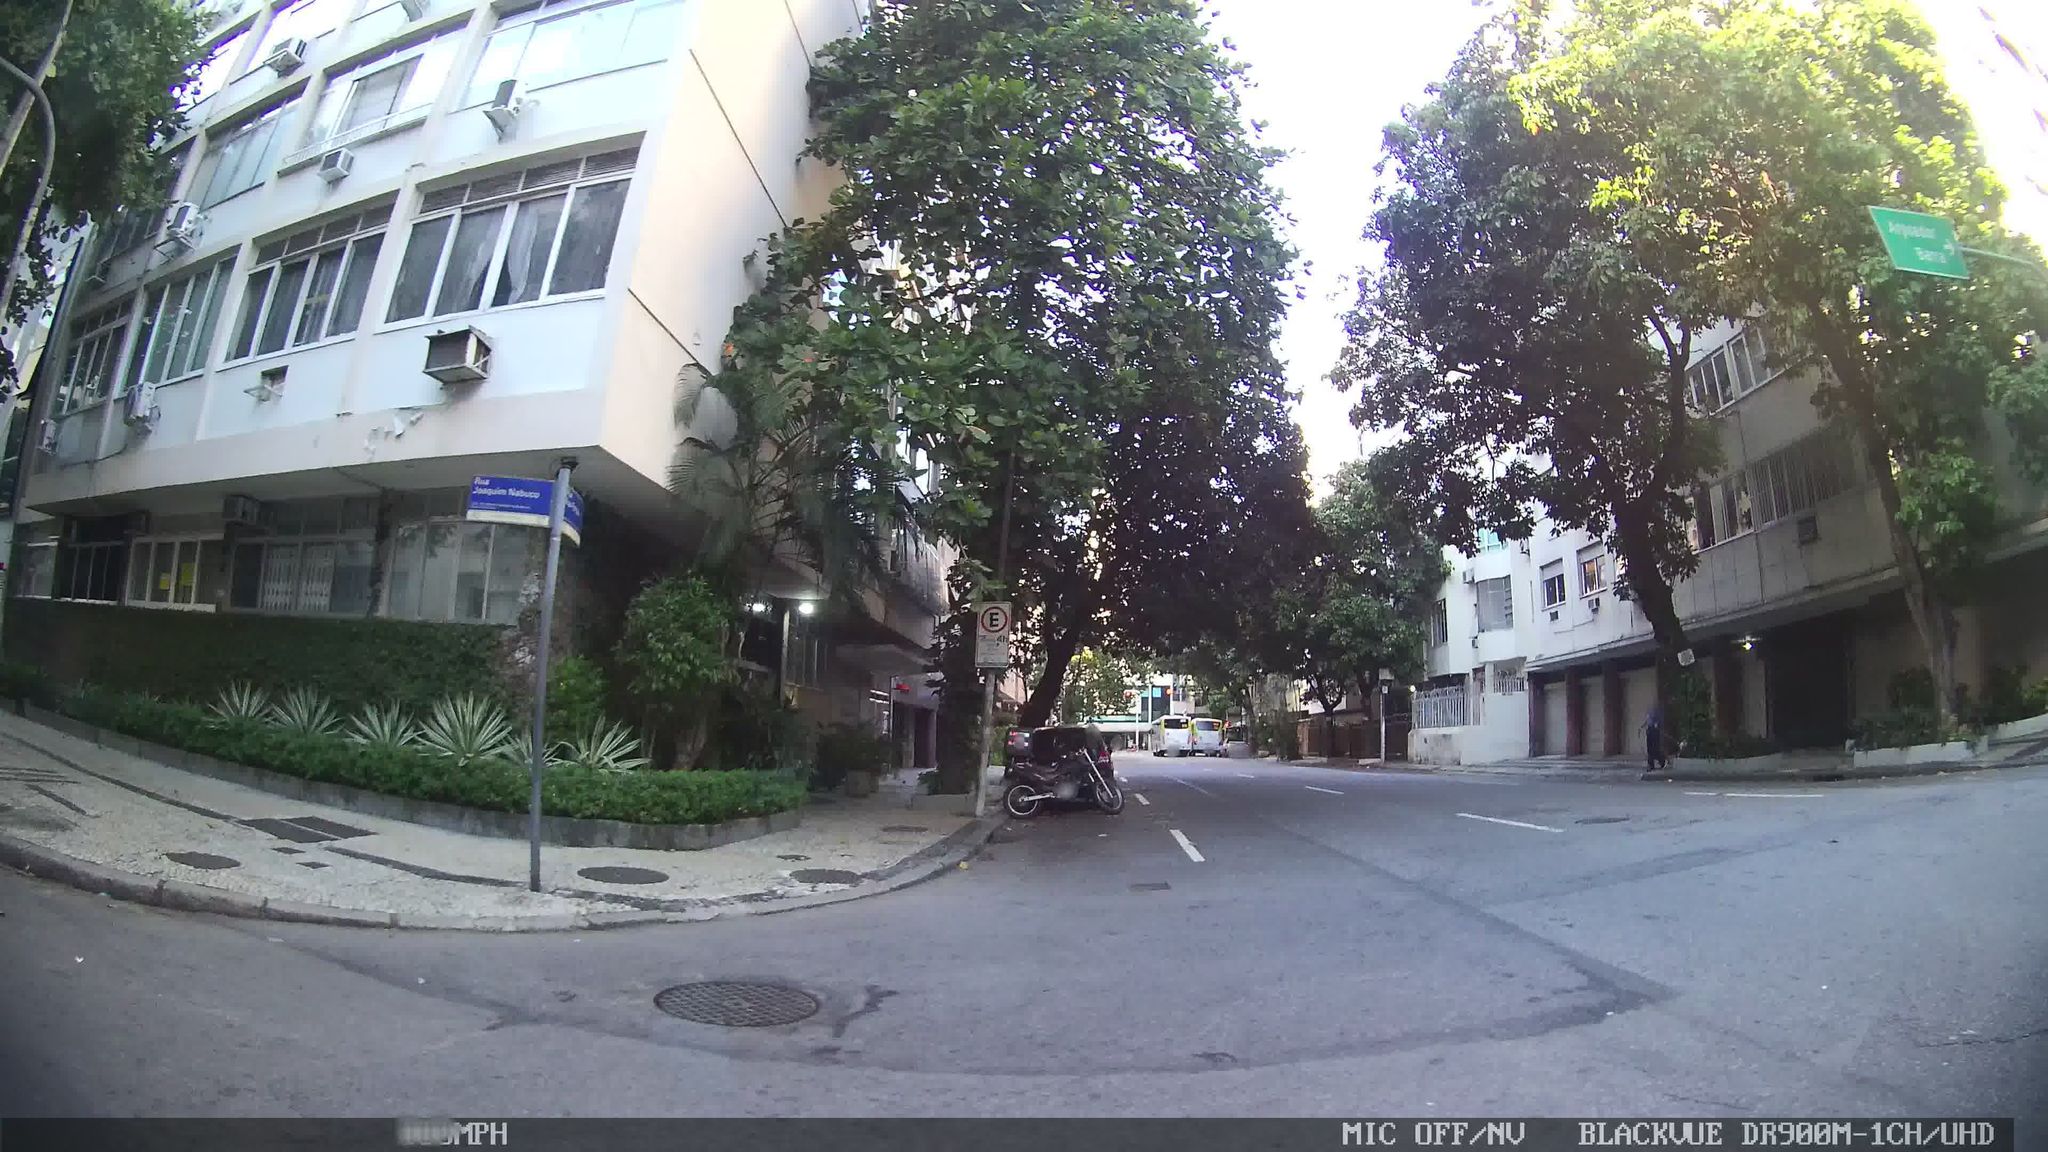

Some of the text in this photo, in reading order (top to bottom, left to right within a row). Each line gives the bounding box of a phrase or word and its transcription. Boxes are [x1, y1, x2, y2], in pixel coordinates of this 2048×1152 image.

[474, 477, 490, 486] Rua
[472, 487, 541, 499] Joaquim Nabuco
[989, 612, 999, 628] E
